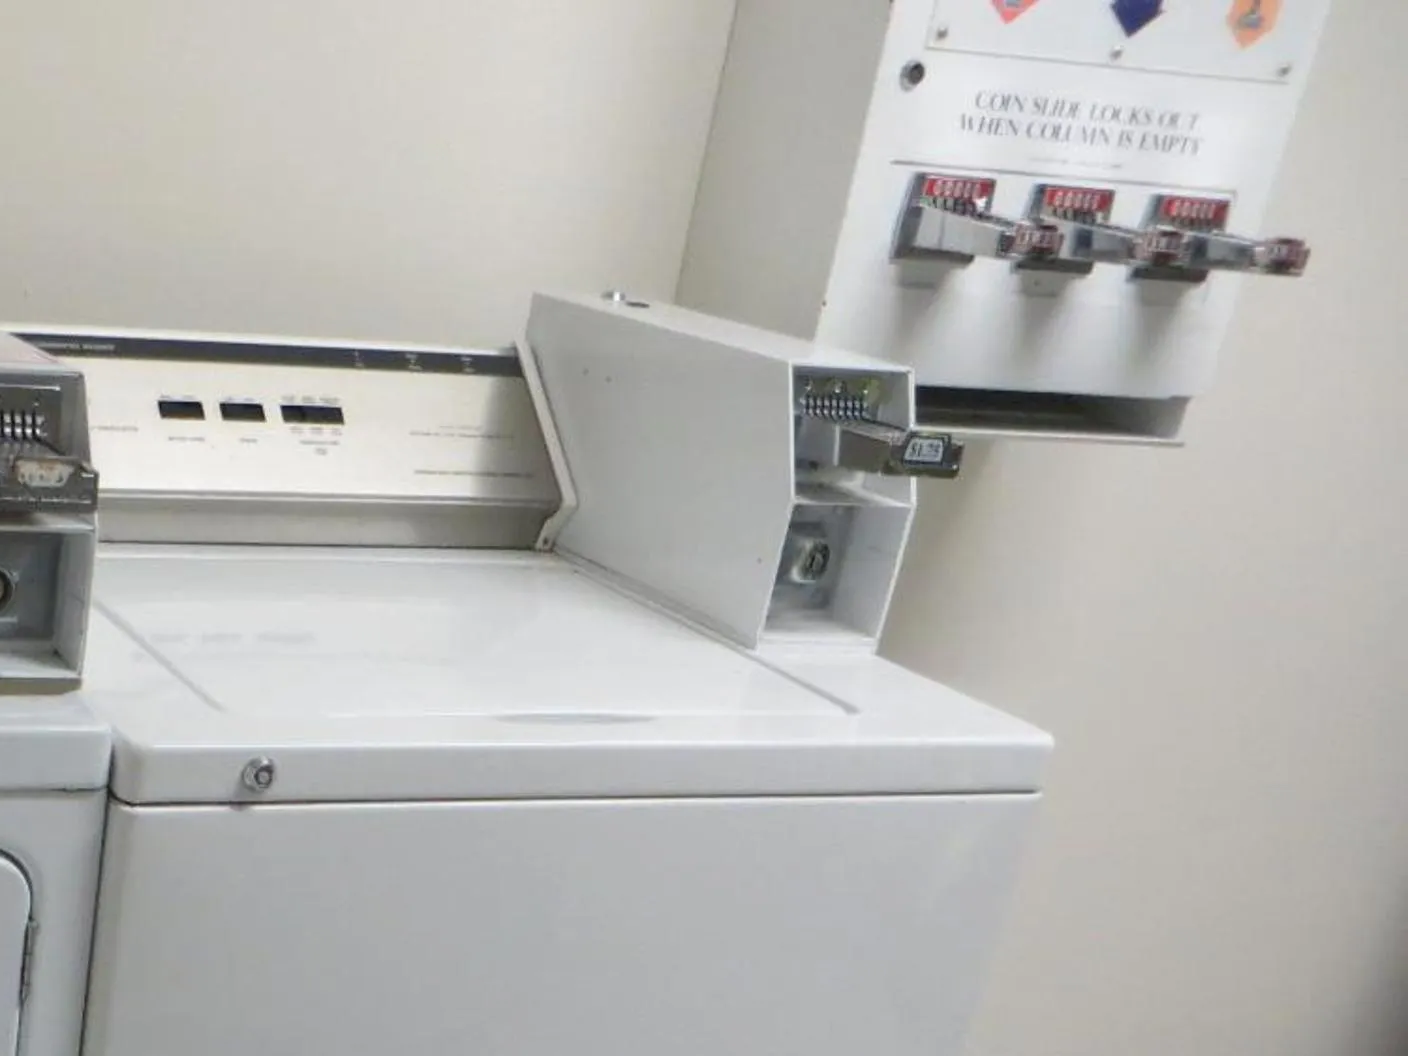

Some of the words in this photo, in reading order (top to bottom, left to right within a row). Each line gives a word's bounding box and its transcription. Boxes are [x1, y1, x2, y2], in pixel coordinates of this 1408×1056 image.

[974, 89, 1028, 113] COIN
[1031, 96, 1081, 120] SLIDE
[1089, 102, 1152, 127] LOCKS
[1157, 110, 1200, 132] OUT
[959, 113, 1020, 137] WHEN
[1025, 120, 1111, 146] COLUMN
[1117, 129, 1133, 149] IS
[1138, 132, 1203, 156] EMPTY
